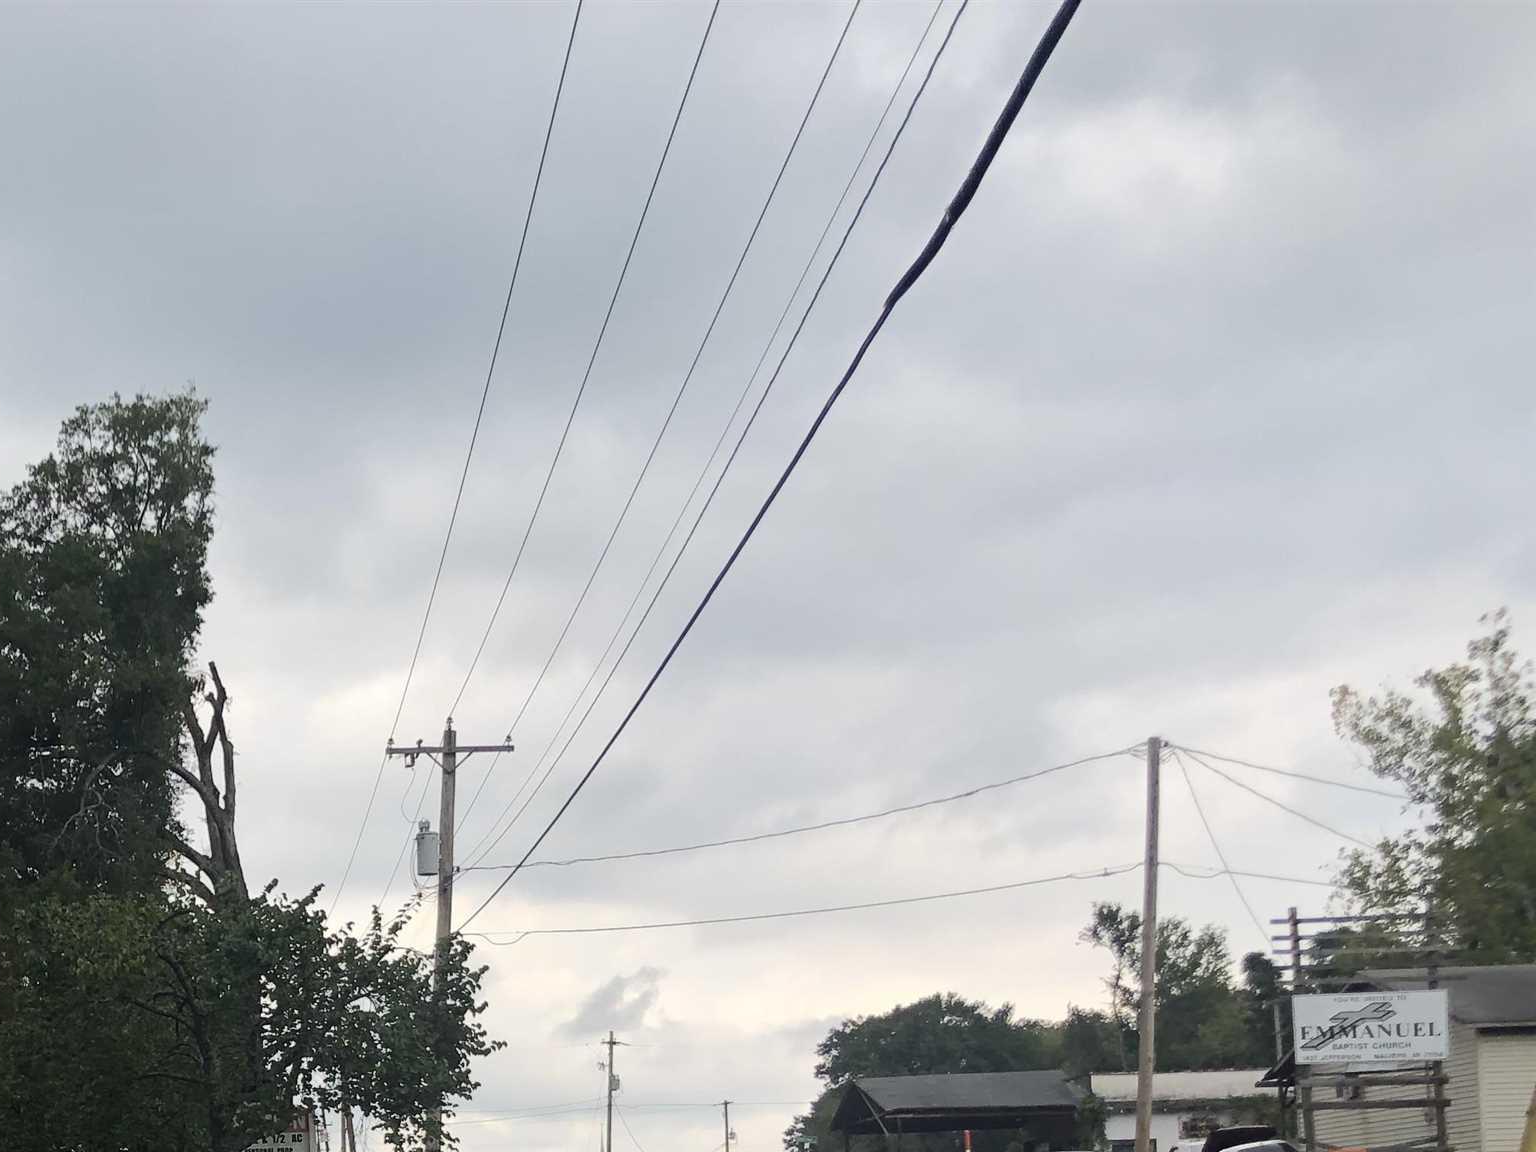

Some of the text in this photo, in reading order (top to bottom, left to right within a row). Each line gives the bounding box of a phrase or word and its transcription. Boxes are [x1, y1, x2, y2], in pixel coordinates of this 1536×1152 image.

[1301, 1021, 1441, 1040] EMMANUEL
[1332, 1041, 1412, 1051] BAPTIST CHURCH
